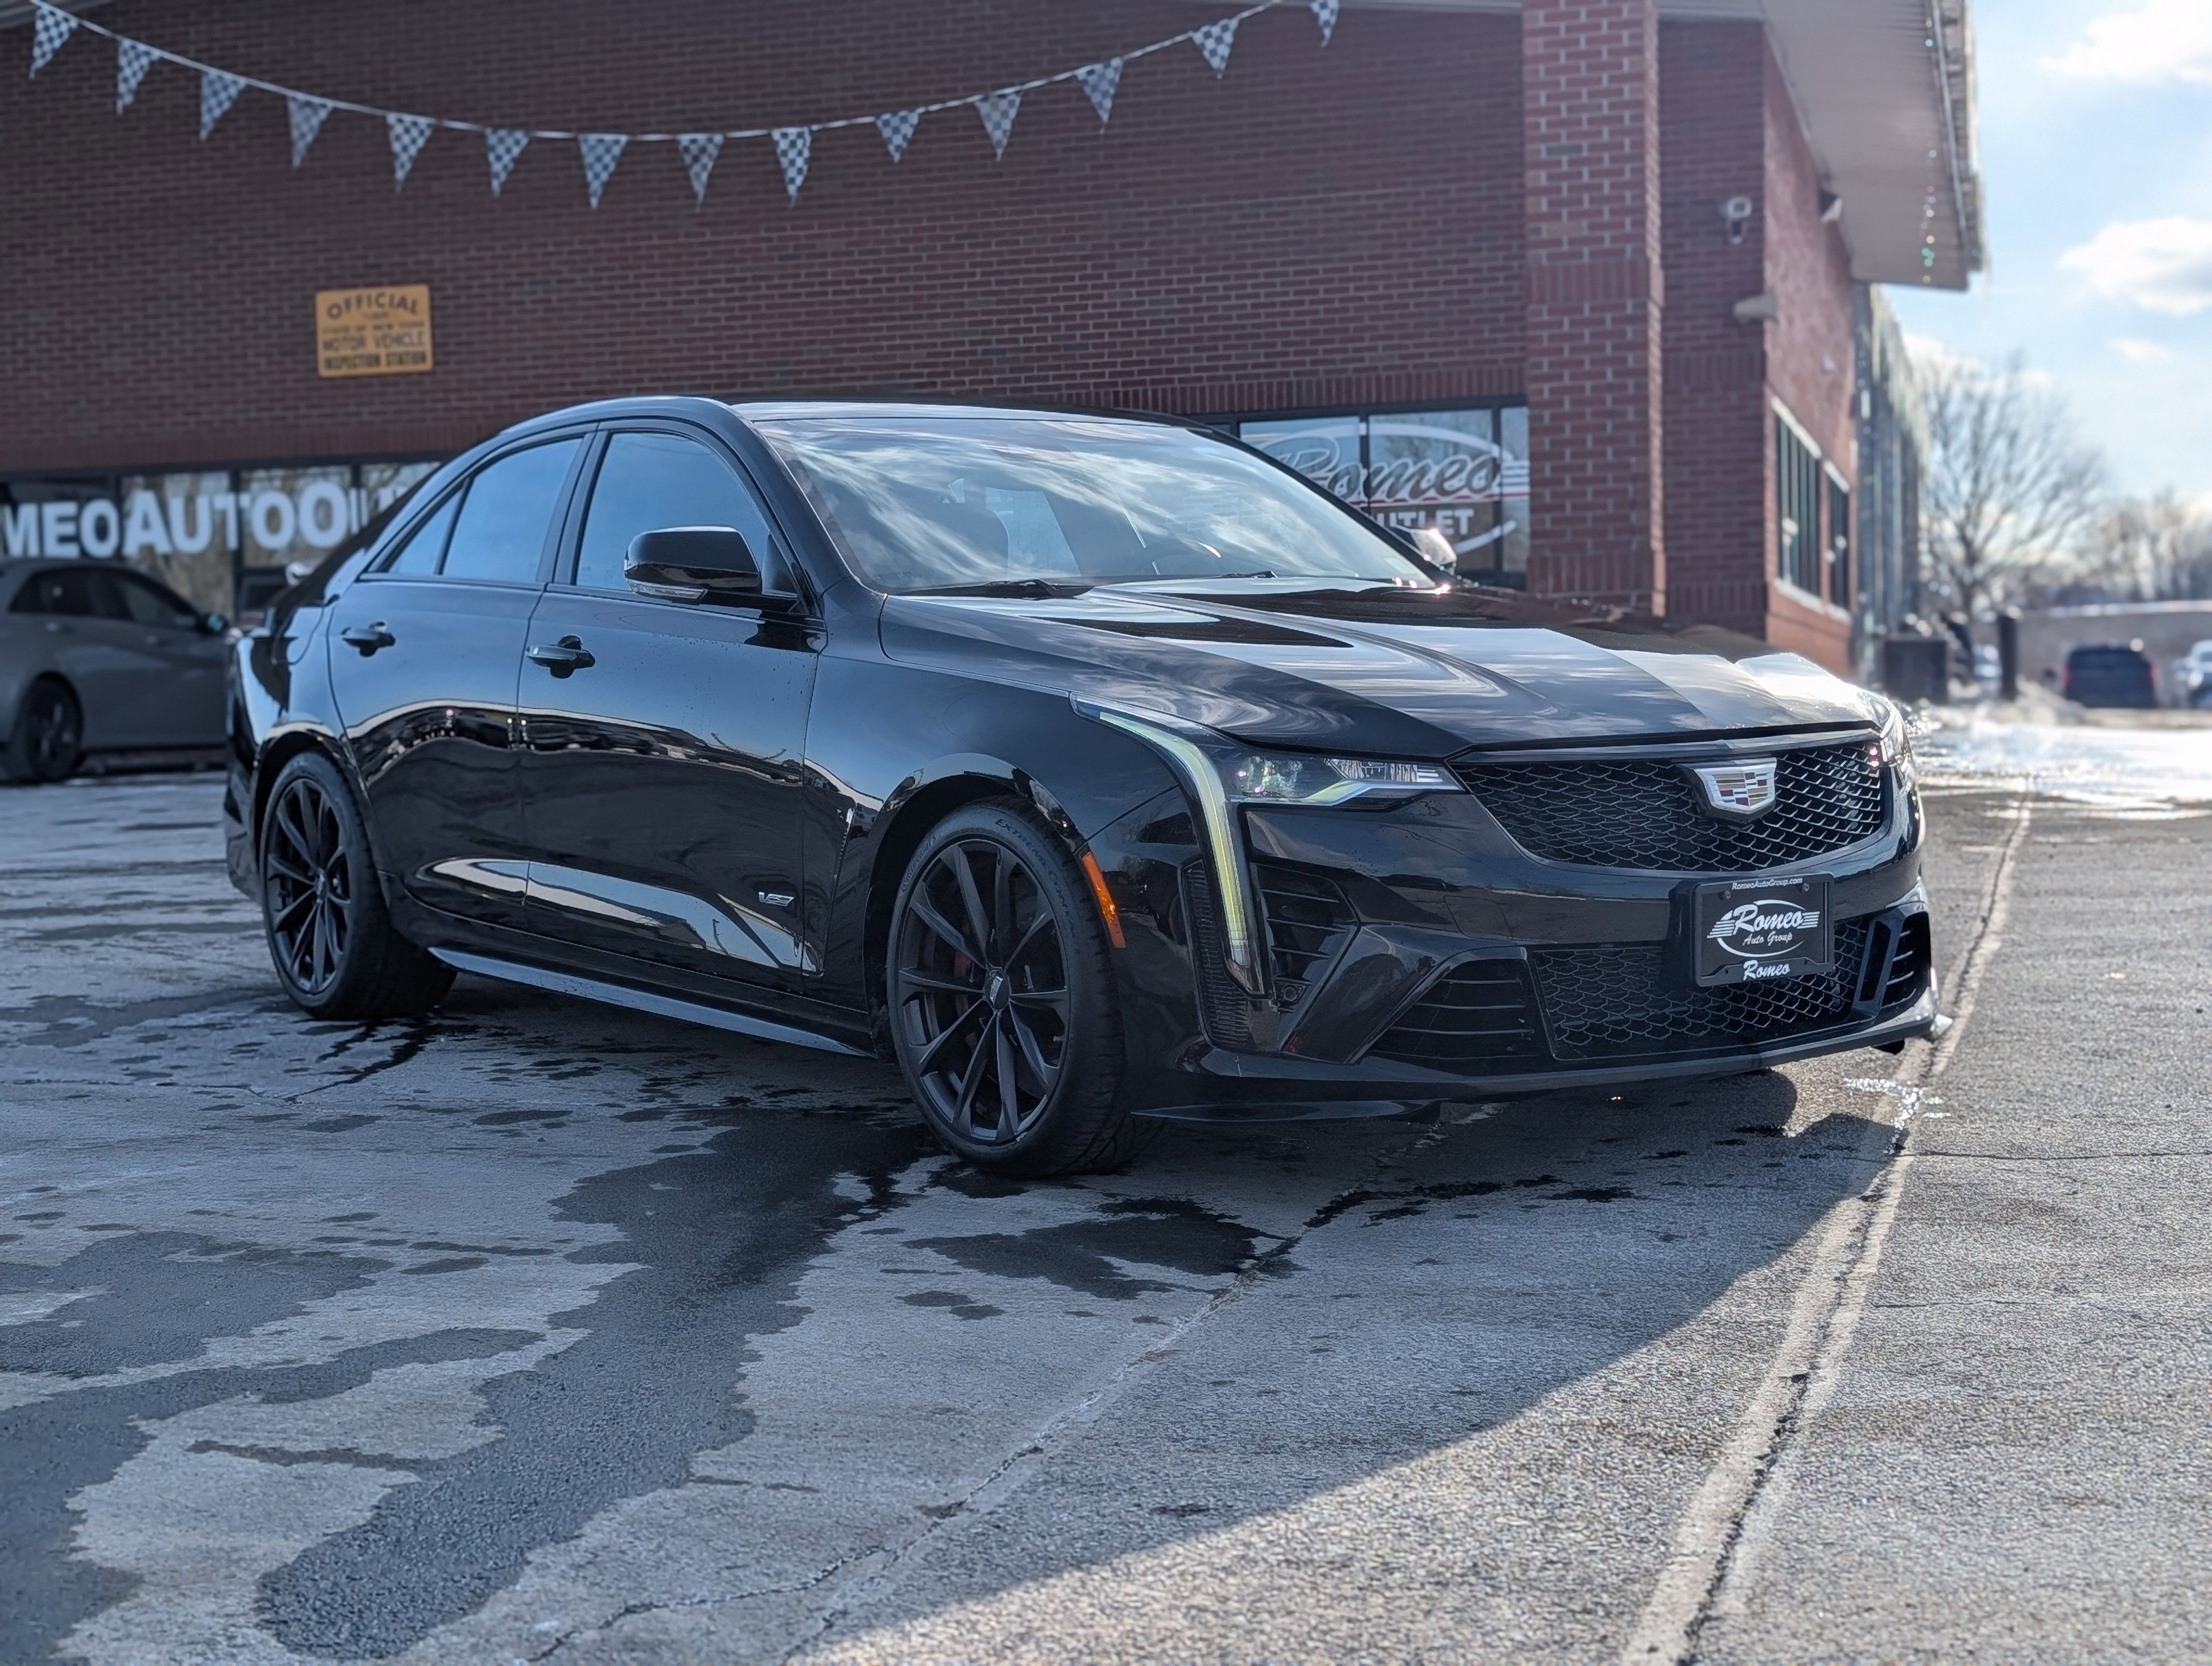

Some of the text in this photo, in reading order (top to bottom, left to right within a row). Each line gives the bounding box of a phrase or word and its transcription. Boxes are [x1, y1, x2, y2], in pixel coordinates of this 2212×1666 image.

[326, 292, 417, 320] OFFICIAL
[1262, 434, 1502, 502] Romeo
[1732, 877, 1803, 890] RomeoAutoGroup.com
[1733, 904, 1804, 935] Romeo
[1742, 931, 1793, 946] Auto Group
[1742, 959, 1791, 981] Romeo
